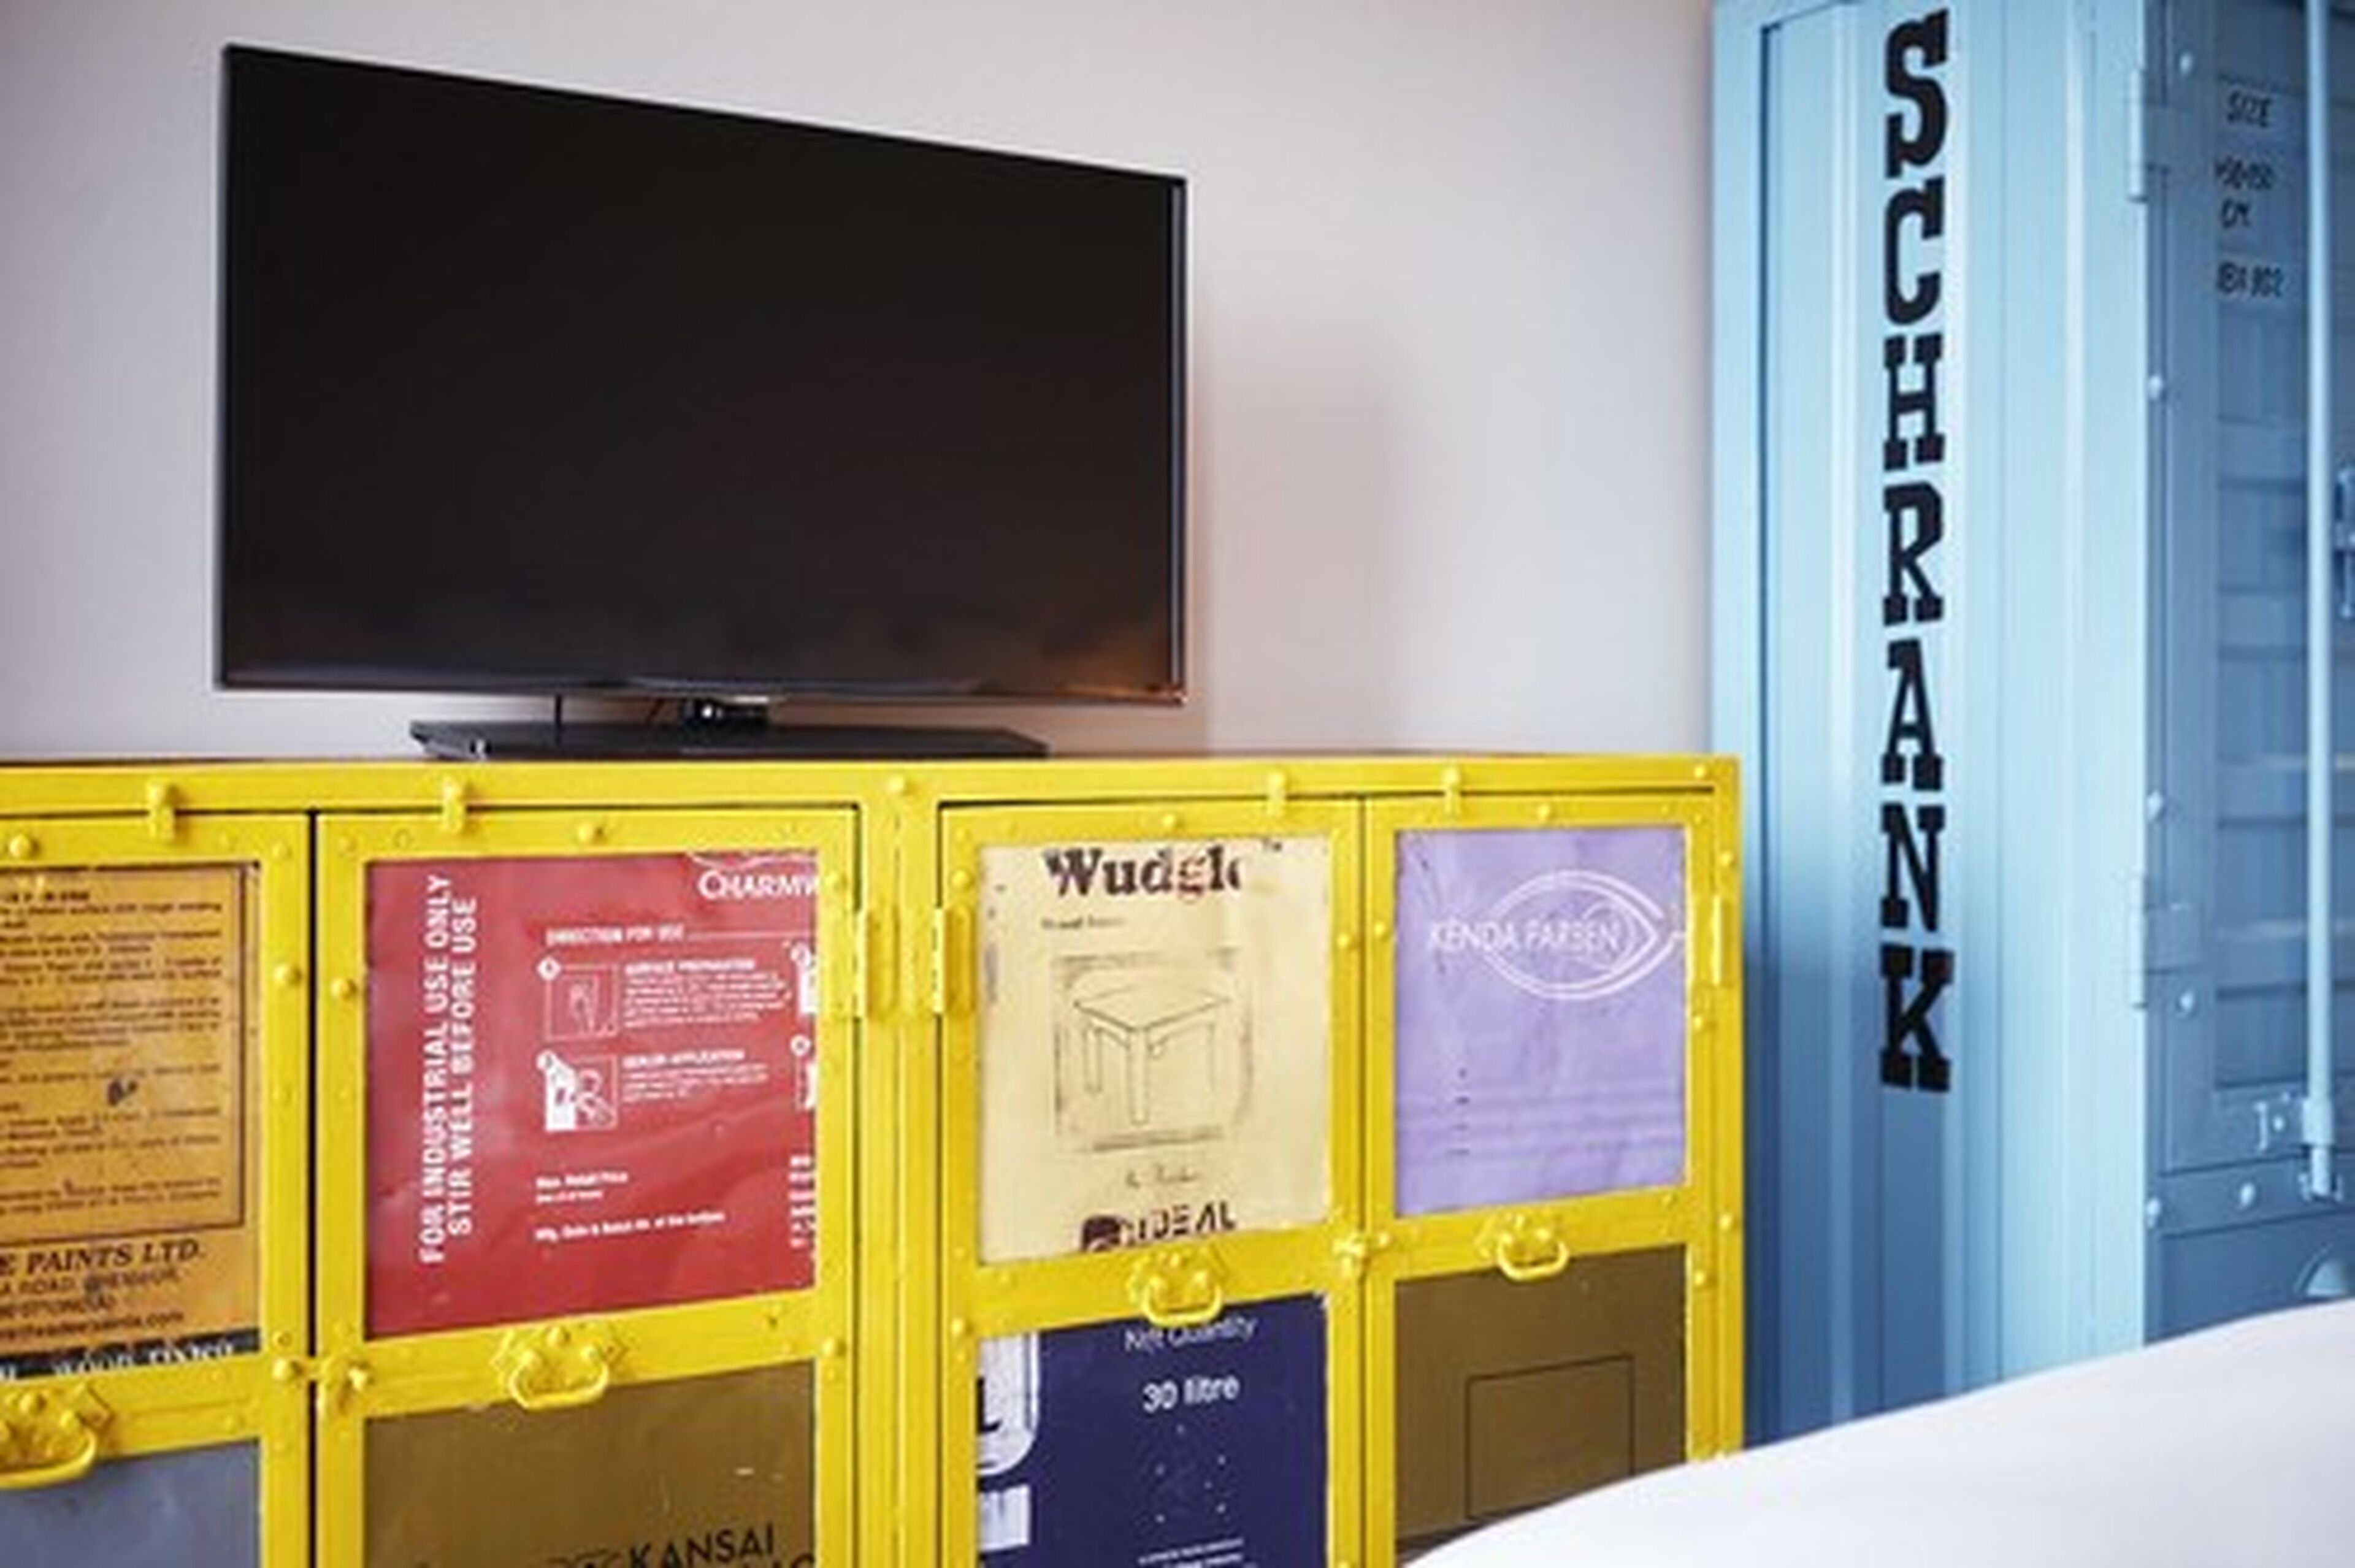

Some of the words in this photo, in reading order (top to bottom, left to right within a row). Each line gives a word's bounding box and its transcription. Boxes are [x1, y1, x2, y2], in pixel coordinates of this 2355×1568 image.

[1880, 8, 1955, 1092] SCHRANK
[424, 874, 452, 949] ONLY
[451, 897, 477, 954] USE
[423, 955, 450, 1014] USE
[451, 960, 477, 1075] BEFORE
[422, 1020, 450, 1198] INDUSTRIAL
[450, 1080, 473, 1161] WELL
[418, 1203, 447, 1263] FOR
[446, 1168, 473, 1235] STIR
[27, 1243, 134, 1274] PAINTS
[142, 1237, 207, 1264] LTD.
[1142, 1380, 1179, 1413] 30
[1183, 1375, 1241, 1405] litre
[629, 1521, 775, 1568] KANSAI
